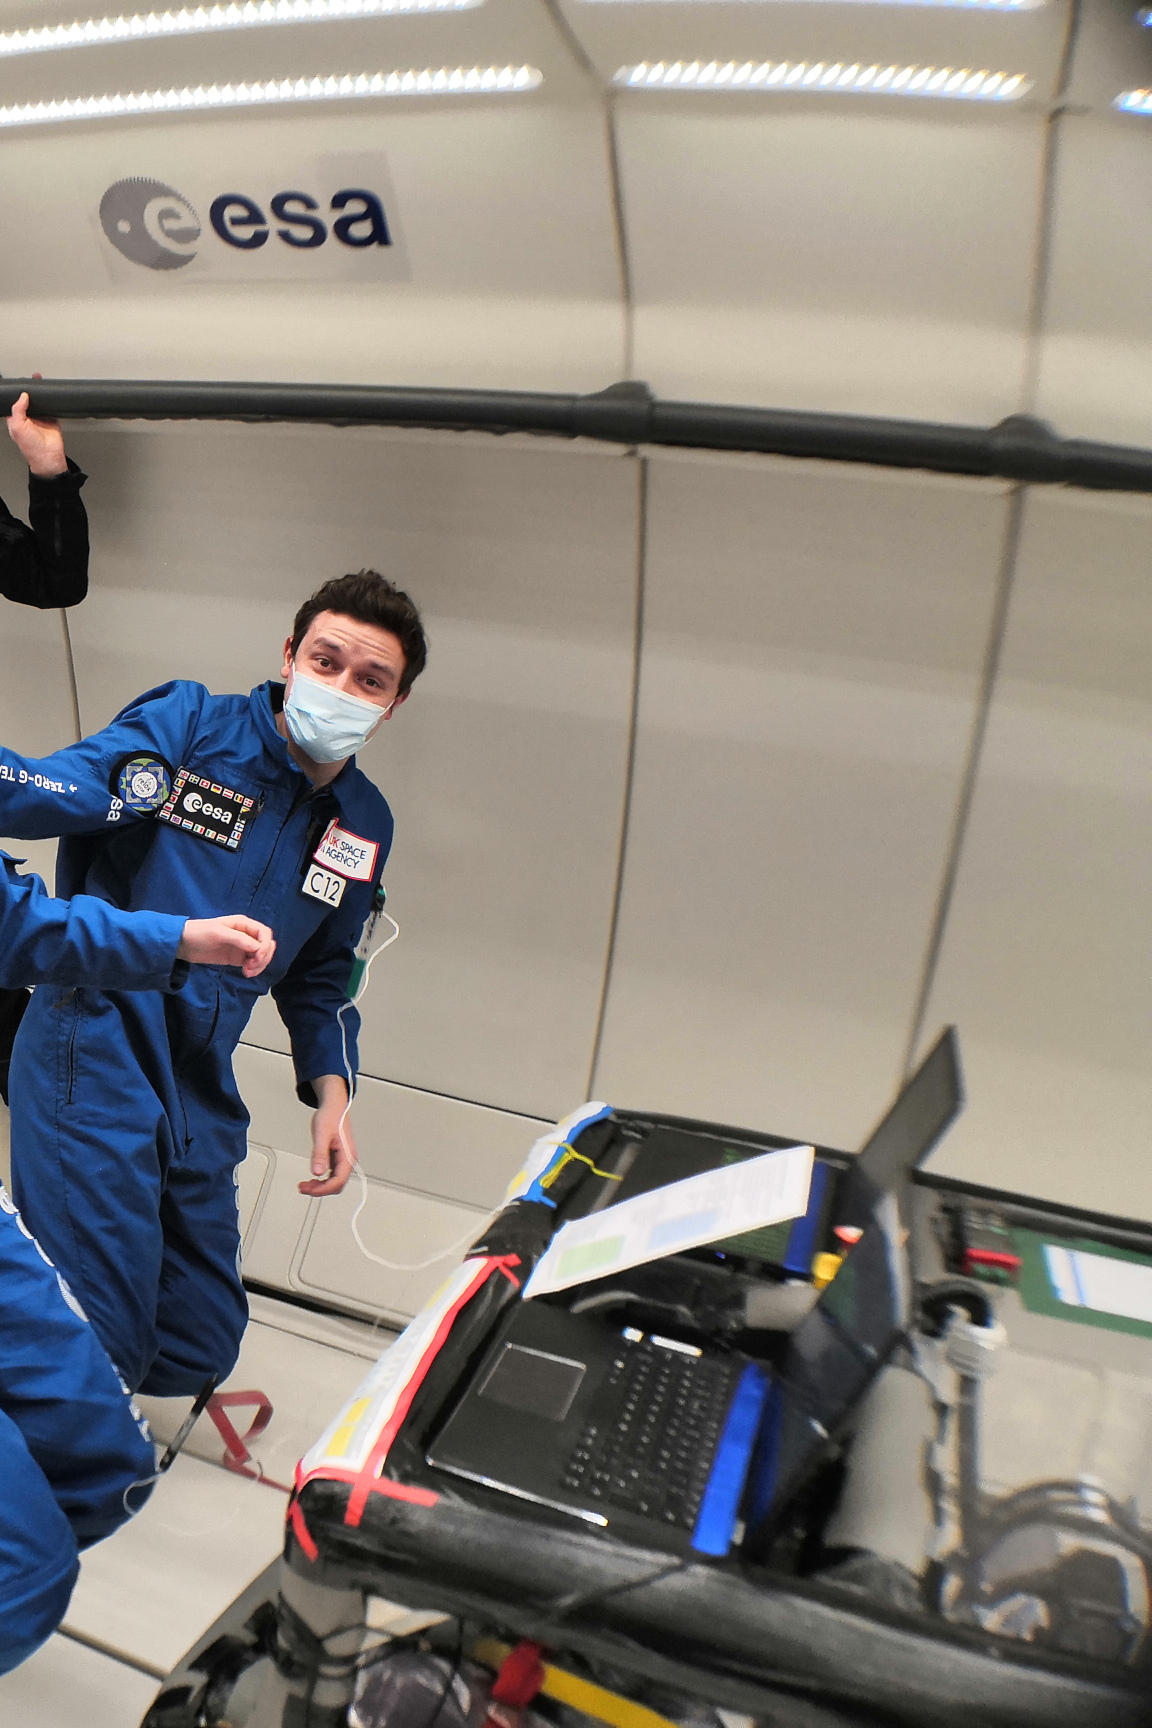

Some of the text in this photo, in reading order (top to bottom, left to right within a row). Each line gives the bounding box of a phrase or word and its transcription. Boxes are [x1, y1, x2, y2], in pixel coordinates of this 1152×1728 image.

[209, 188, 392, 250] esa
[18, 769, 66, 793] ZERO-G
[106, 796, 124, 822] sa
[201, 802, 233, 825] esa
[325, 847, 360, 869] AGENCY
[329, 834, 367, 860] UK SPACE
[310, 872, 340, 901] C12
